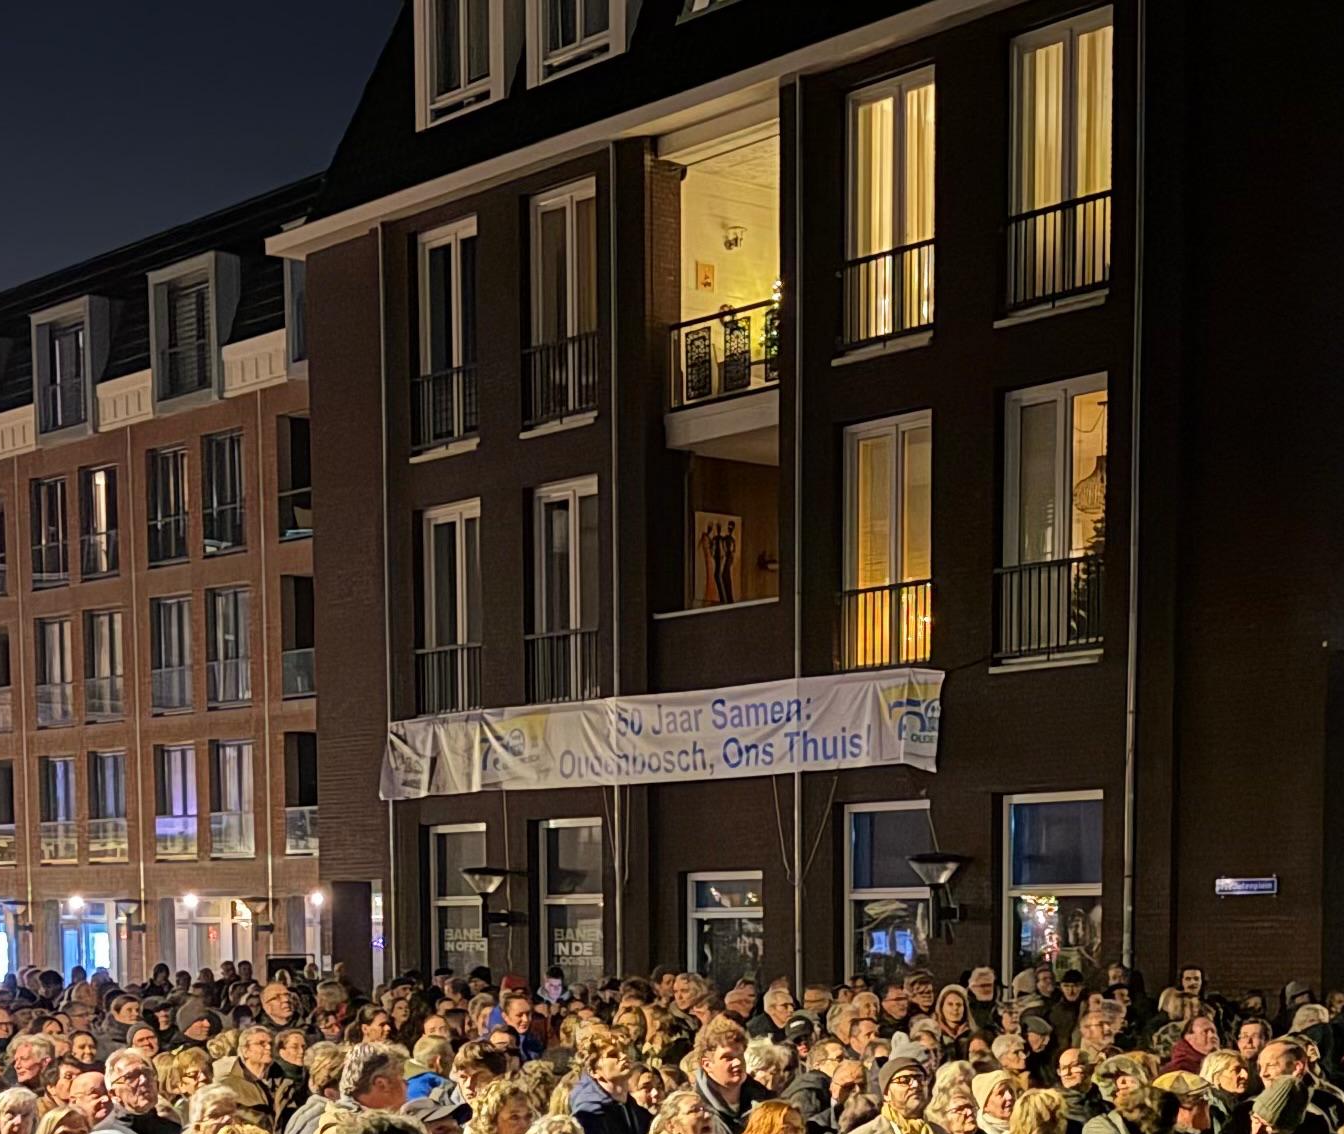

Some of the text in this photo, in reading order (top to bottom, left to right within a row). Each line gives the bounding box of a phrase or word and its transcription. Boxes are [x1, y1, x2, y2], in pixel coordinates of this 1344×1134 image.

[651, 704, 703, 735] Jaar
[711, 697, 811, 730] Samen:
[723, 736, 774, 768] Ons
[784, 723, 872, 763] Thuis!
[444, 928, 482, 940] BANE
[554, 942, 593, 955] IN DE
[554, 956, 603, 966] LOGISTIE
